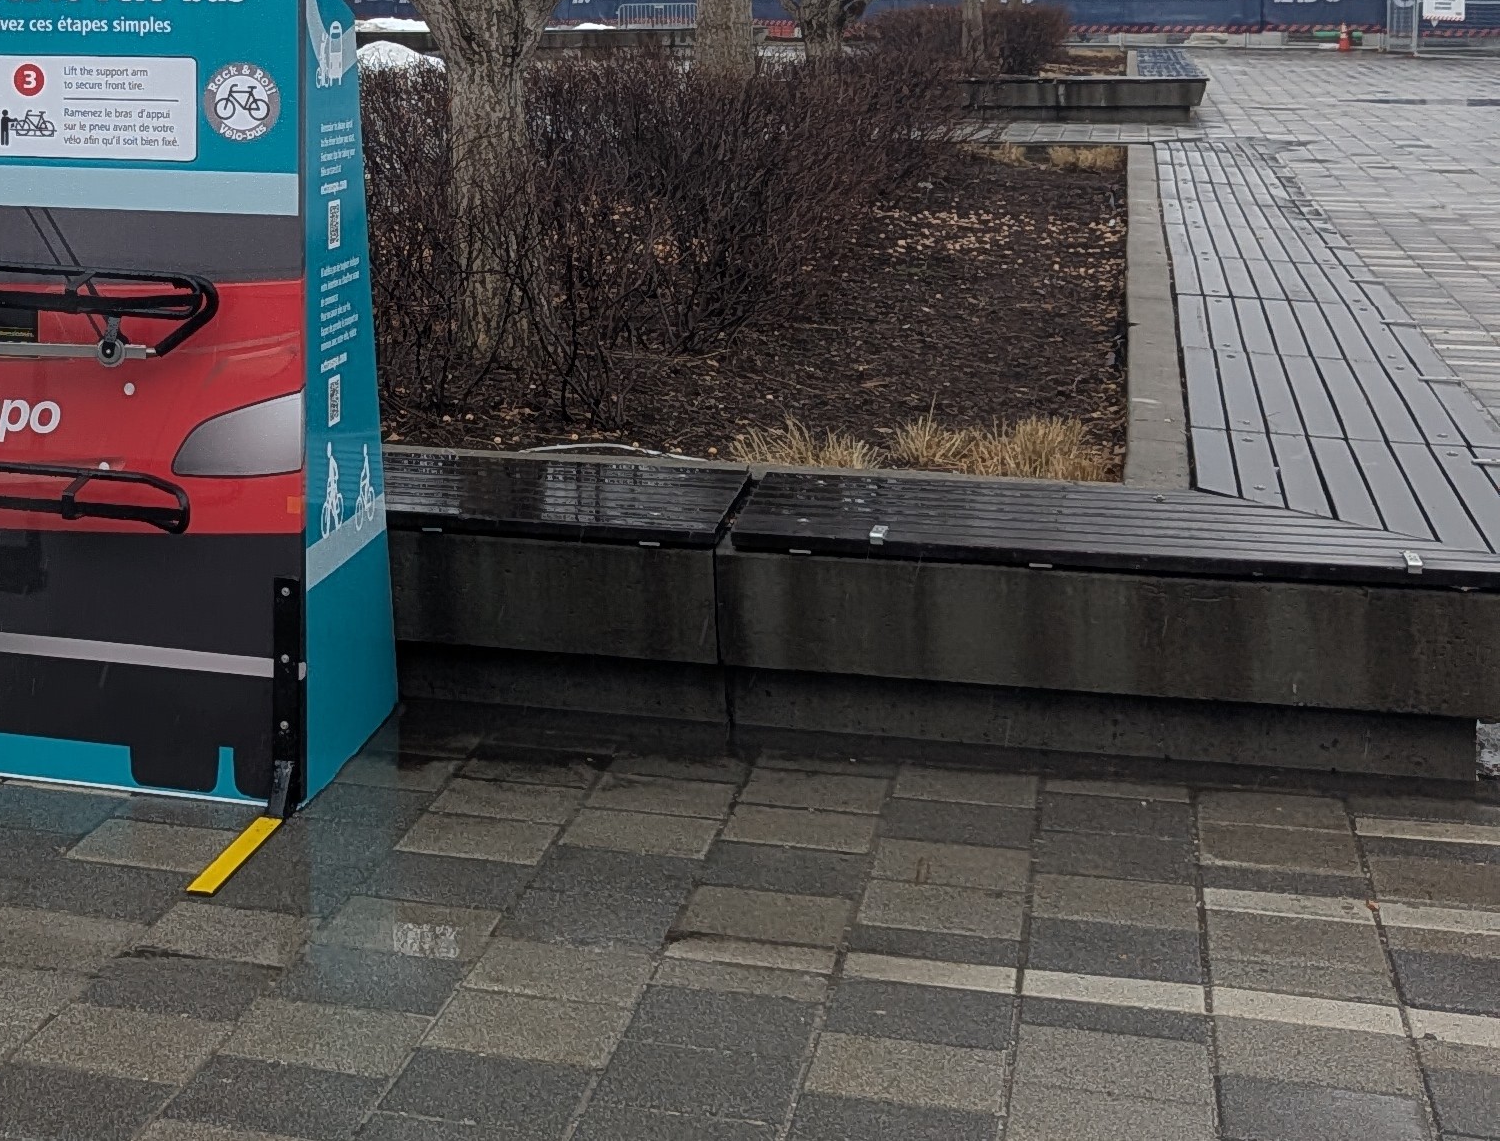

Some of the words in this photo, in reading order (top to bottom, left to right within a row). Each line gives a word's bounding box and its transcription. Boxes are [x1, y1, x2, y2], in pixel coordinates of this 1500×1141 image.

[29, 18, 53, 32] ces
[57, 15, 108, 35] étapes
[112, 16, 171, 36] simples
[63, 66, 78, 76] Lift
[80, 66, 94, 76] the
[96, 68, 129, 79] support
[131, 69, 149, 77] arm
[23, 70, 37, 89] 3
[63, 80, 73, 90] to
[75, 81, 103, 90] secure
[105, 80, 127, 90] front
[208, 65, 239, 93] Rack
[241, 64, 251, 75] &
[254, 68, 277, 95] Roll
[63, 107, 103, 118] Ramenez
[104, 107, 113, 118] le
[114, 108, 133, 119] bras
[63, 123, 76, 131] sur
[79, 121, 87, 131] le
[88, 123, 111, 133] pneu
[112, 123, 137, 133] avant
[138, 122, 150, 133] de
[152, 124, 175, 133] votre
[219, 123, 267, 141] Vélo-bus
[63, 135, 82, 145] vélo
[83, 135, 100, 146] afin
[122, 136, 139, 146] soit
[140, 136, 160, 147] bien
